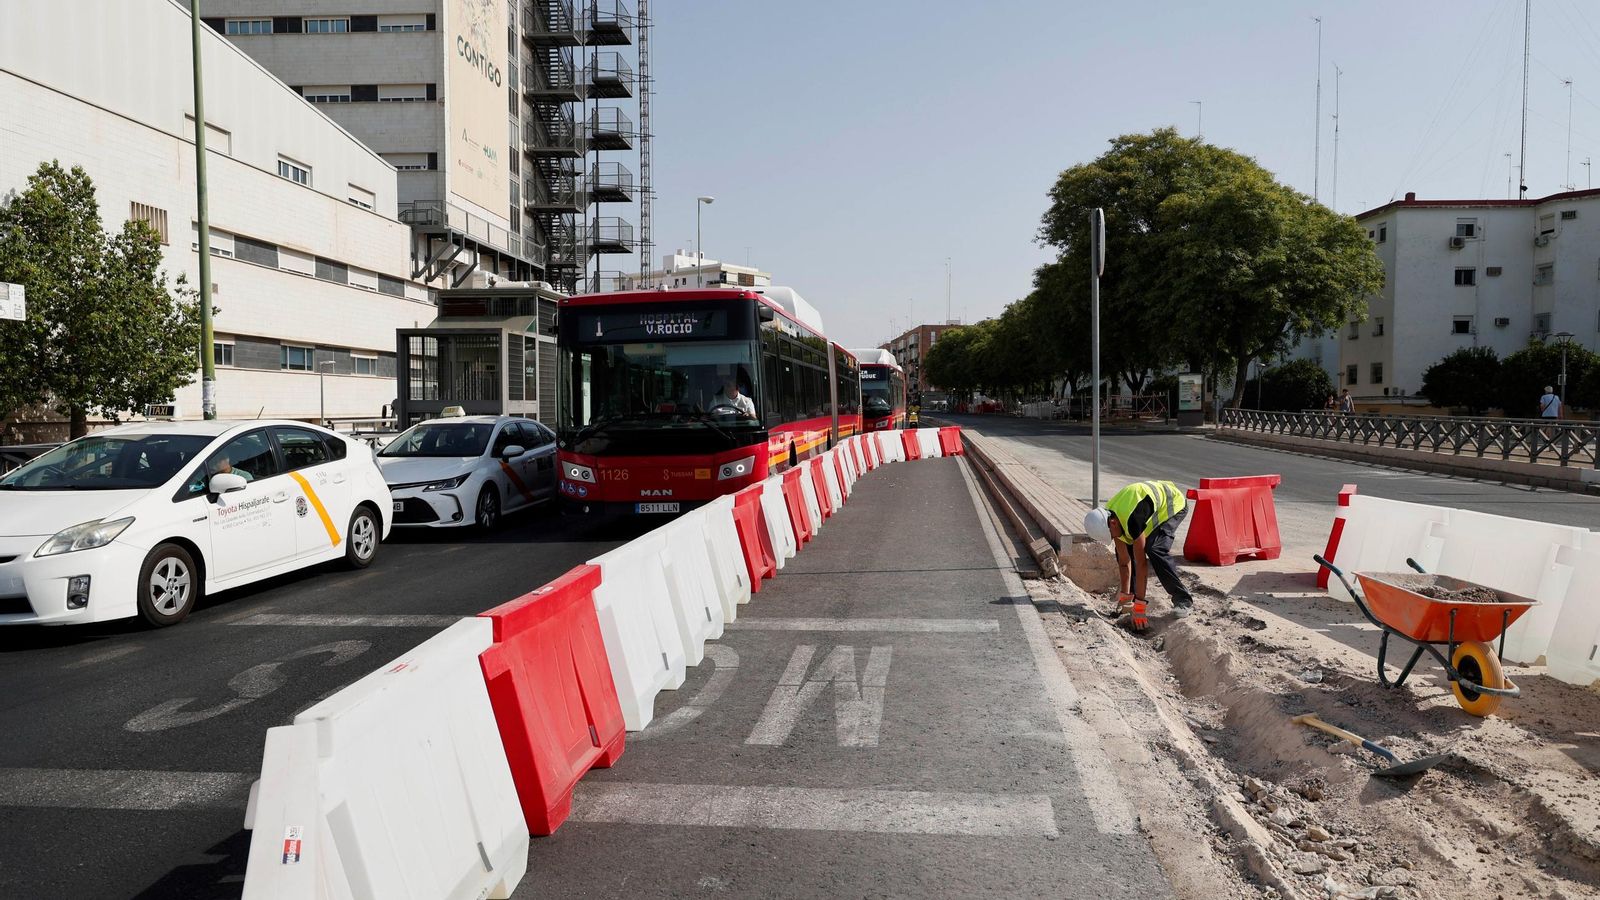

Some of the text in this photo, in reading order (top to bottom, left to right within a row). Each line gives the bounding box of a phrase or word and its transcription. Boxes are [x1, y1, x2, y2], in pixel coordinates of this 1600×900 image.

[457, 35, 501, 87] CONTIGO
[639, 312, 698, 325] HOSPITAL
[595, 316, 604, 337] 1
[151, 406, 168, 415] TAXI
[600, 468, 630, 481] 1126
[217, 505, 238, 518] Toyota
[640, 504, 678, 512] 8511 LLN
